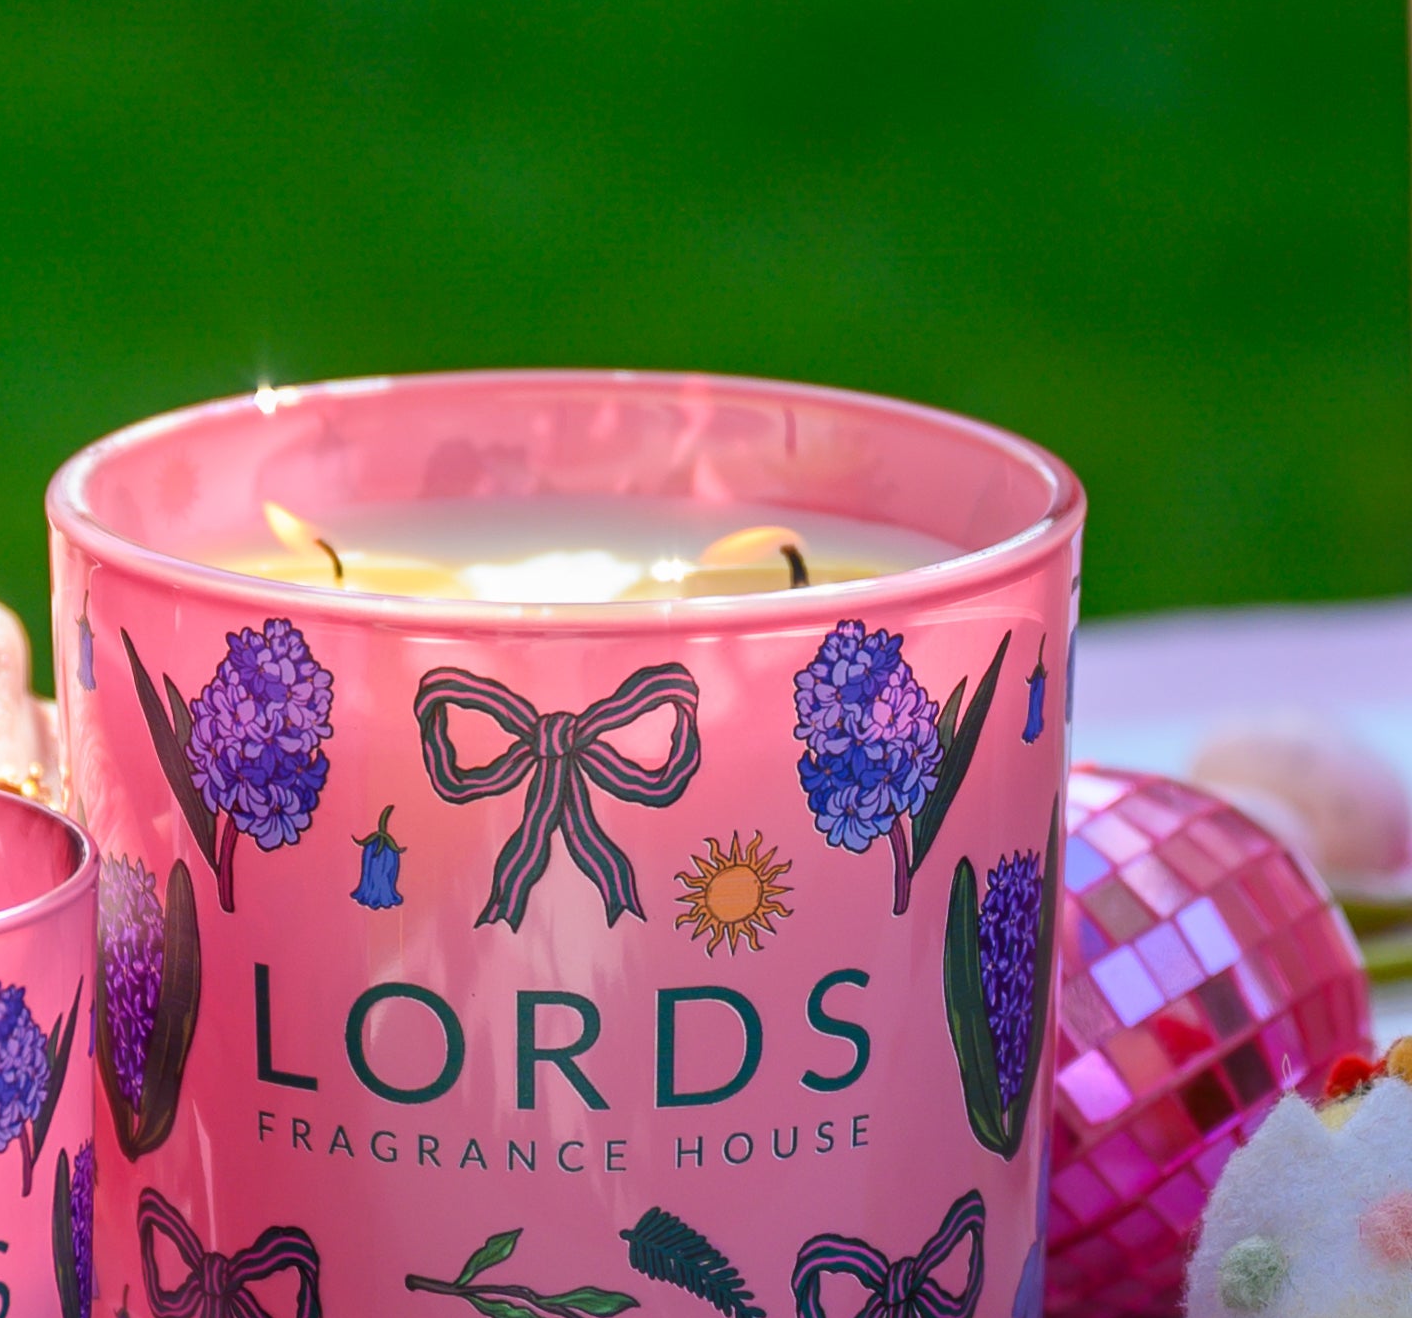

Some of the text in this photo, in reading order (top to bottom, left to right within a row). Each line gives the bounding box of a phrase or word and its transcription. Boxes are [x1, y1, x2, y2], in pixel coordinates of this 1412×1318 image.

[254, 961, 871, 1111] LORDS
[257, 1111, 871, 1173] FRAGRANCE HOUSE
